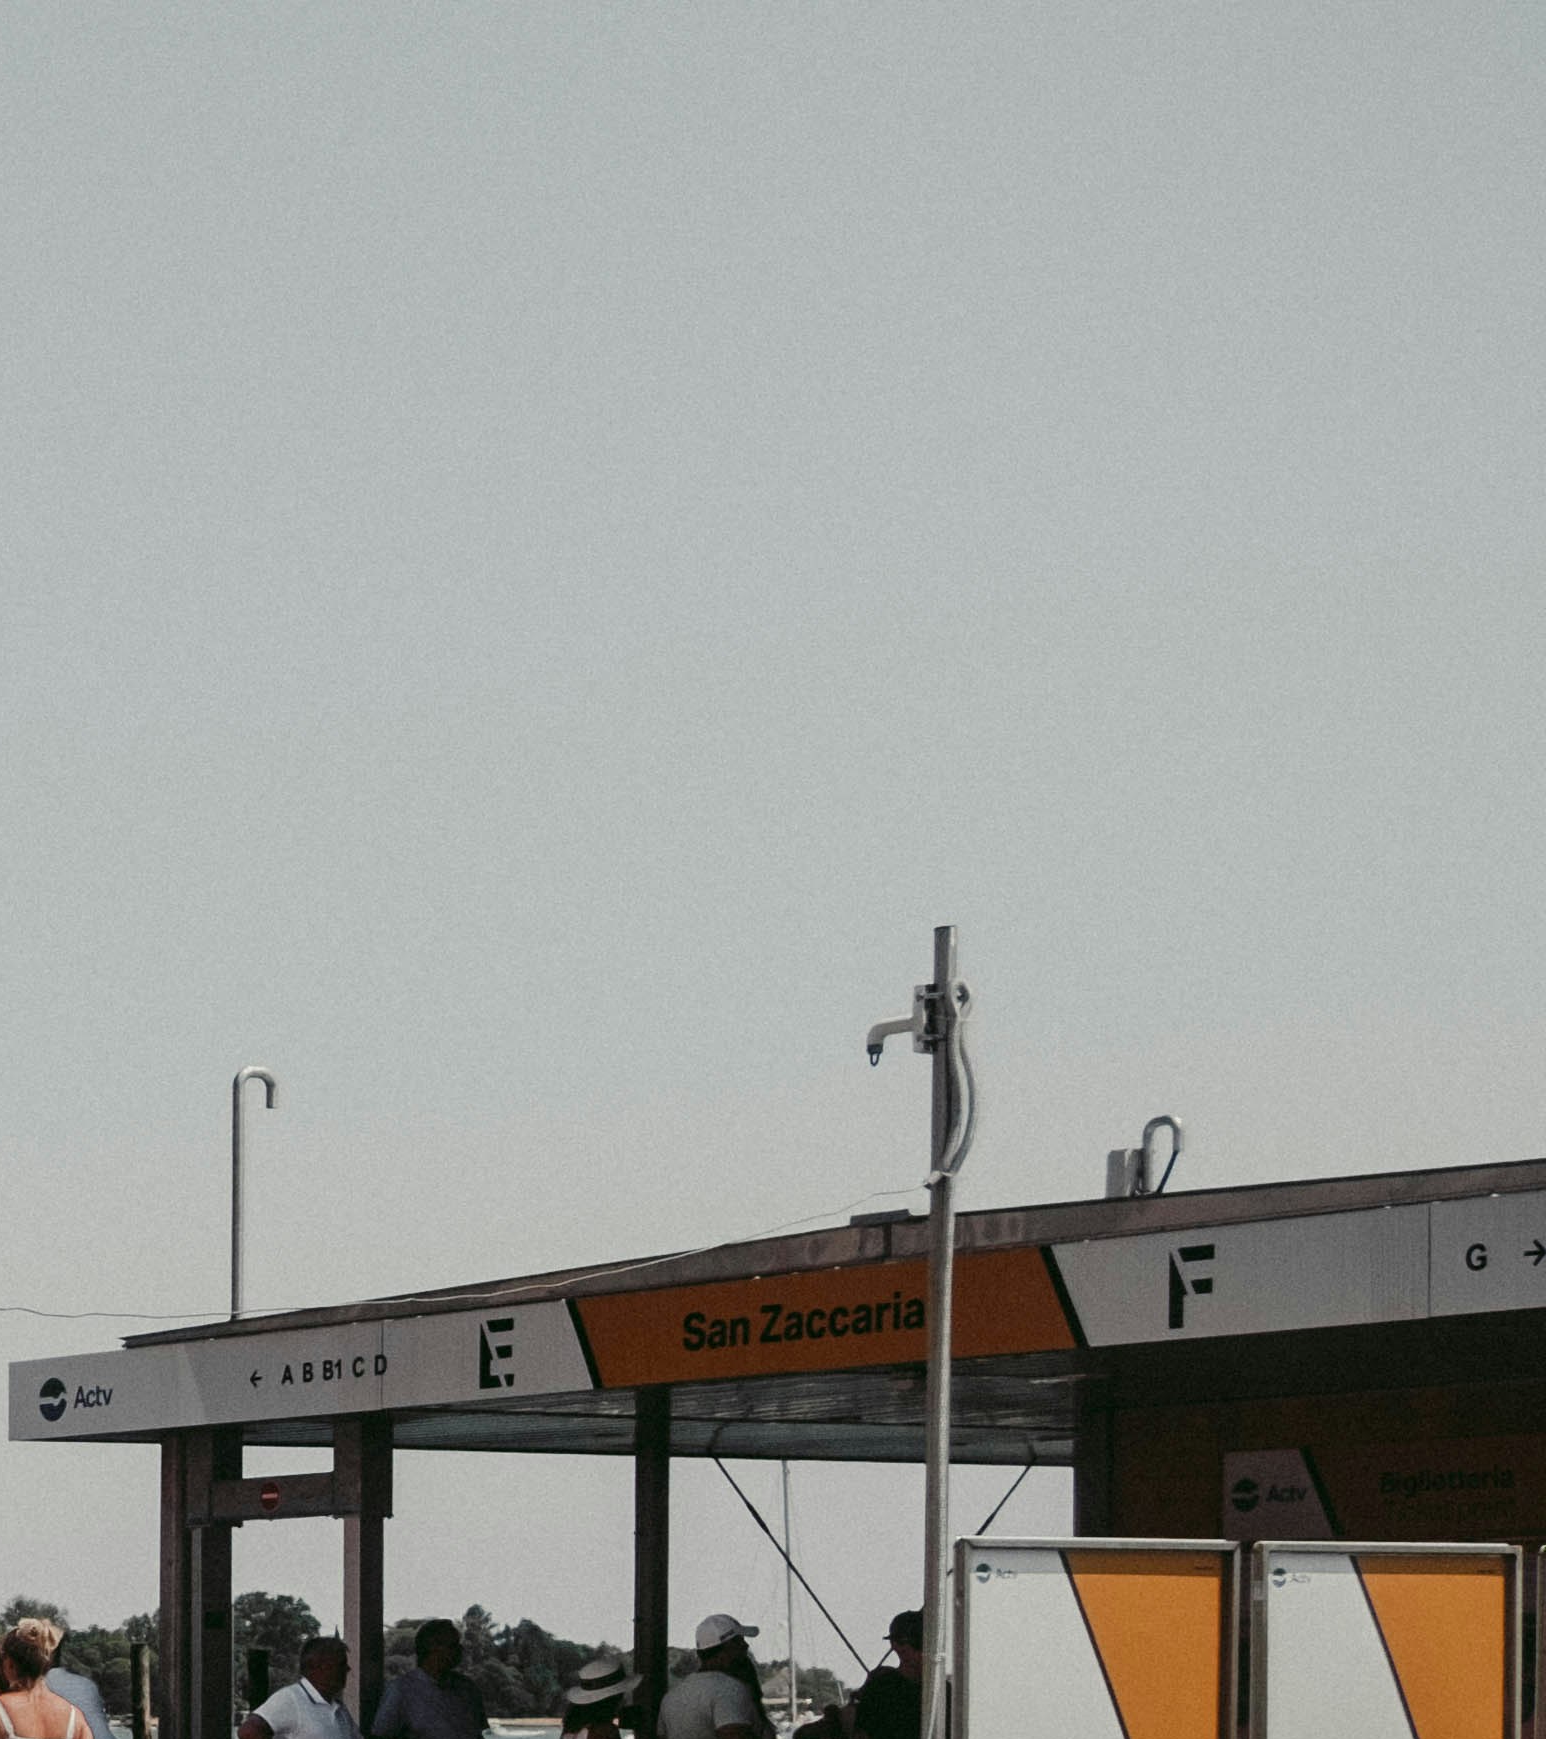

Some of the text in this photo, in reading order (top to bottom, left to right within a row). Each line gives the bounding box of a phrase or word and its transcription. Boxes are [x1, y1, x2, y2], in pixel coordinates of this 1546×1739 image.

[1465, 1243, 1489, 1271] G
[1168, 1243, 1215, 1329] F
[682, 1291, 927, 1351] San Zaccaria
[479, 1317, 514, 1390] E
[281, 1355, 387, 1386] A B B1 C D
[74, 1386, 113, 1409] Actv
[1266, 1484, 1307, 1501] Actv
